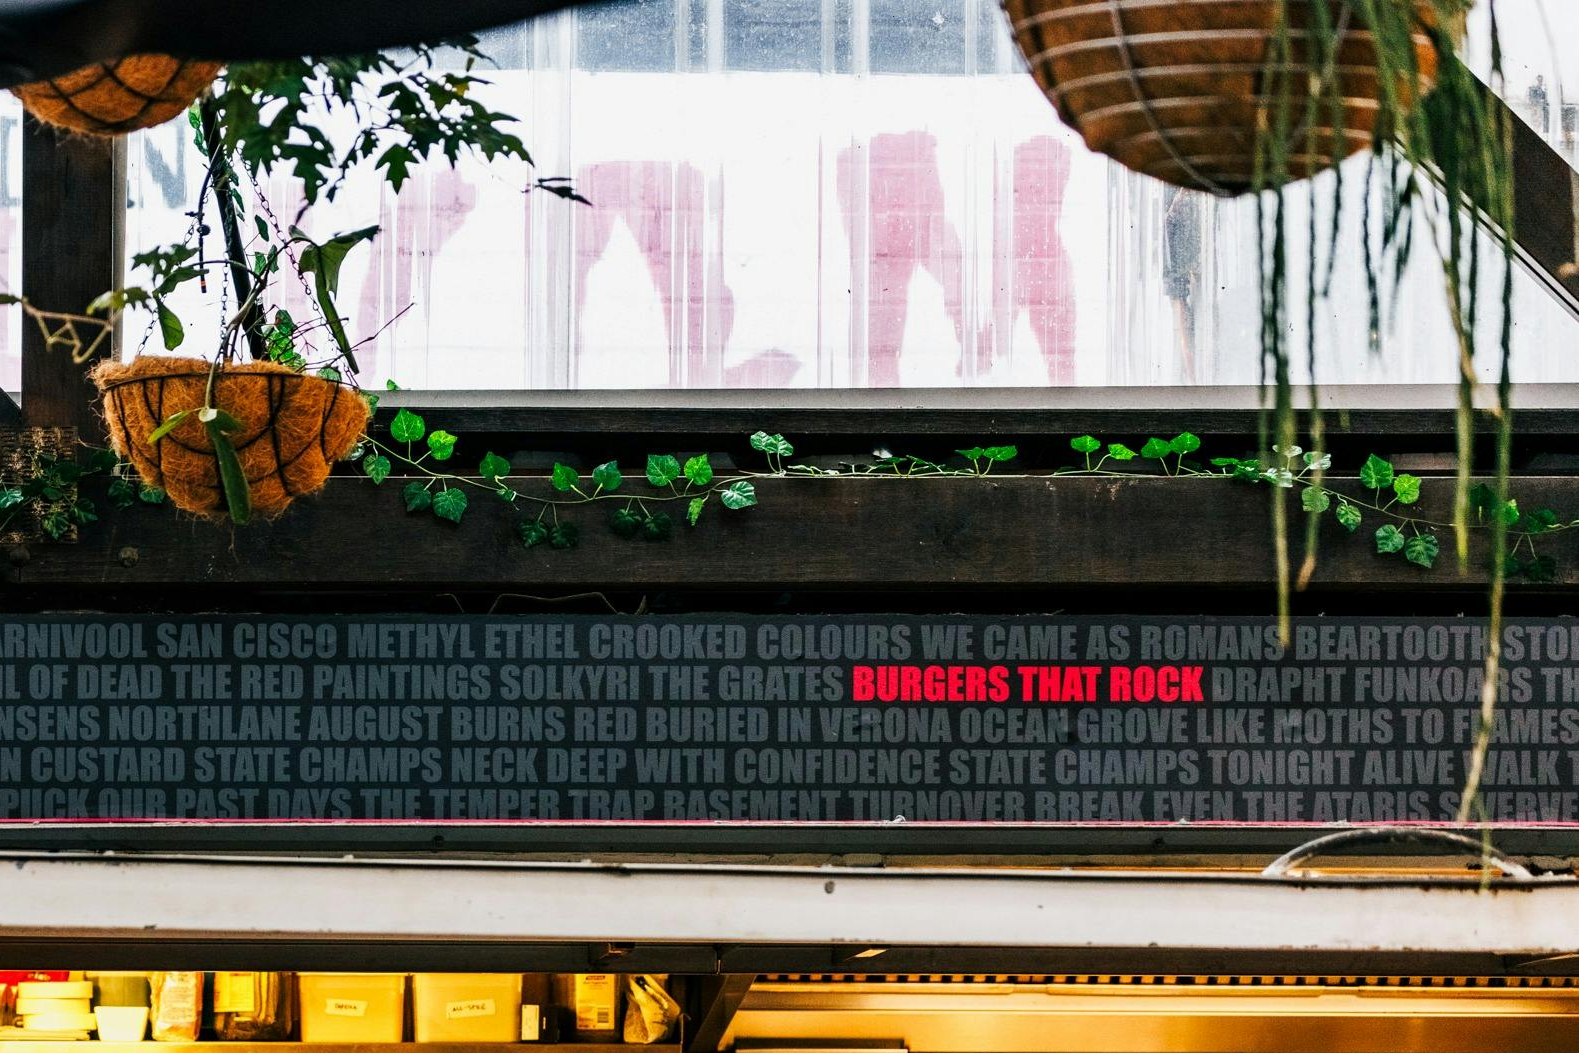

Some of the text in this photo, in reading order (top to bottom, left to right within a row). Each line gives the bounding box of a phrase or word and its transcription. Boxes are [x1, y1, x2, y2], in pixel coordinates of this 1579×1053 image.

[158, 624, 223, 659] SAN
[235, 624, 338, 659] CISCO
[350, 625, 476, 659] METHYL
[486, 625, 580, 659] ETHEL
[590, 625, 747, 660] CROOKED
[758, 625, 912, 661] COLOURS
[922, 626, 974, 660] WE
[985, 626, 1077, 661] CAME
[1087, 626, 1131, 661] AS
[1142, 624, 1283, 661] ROMANS
[315, 665, 1347, 702] PAINTINGS SOLKYRI THE GRATES BURGERS THAT ROCK DRAPHT
